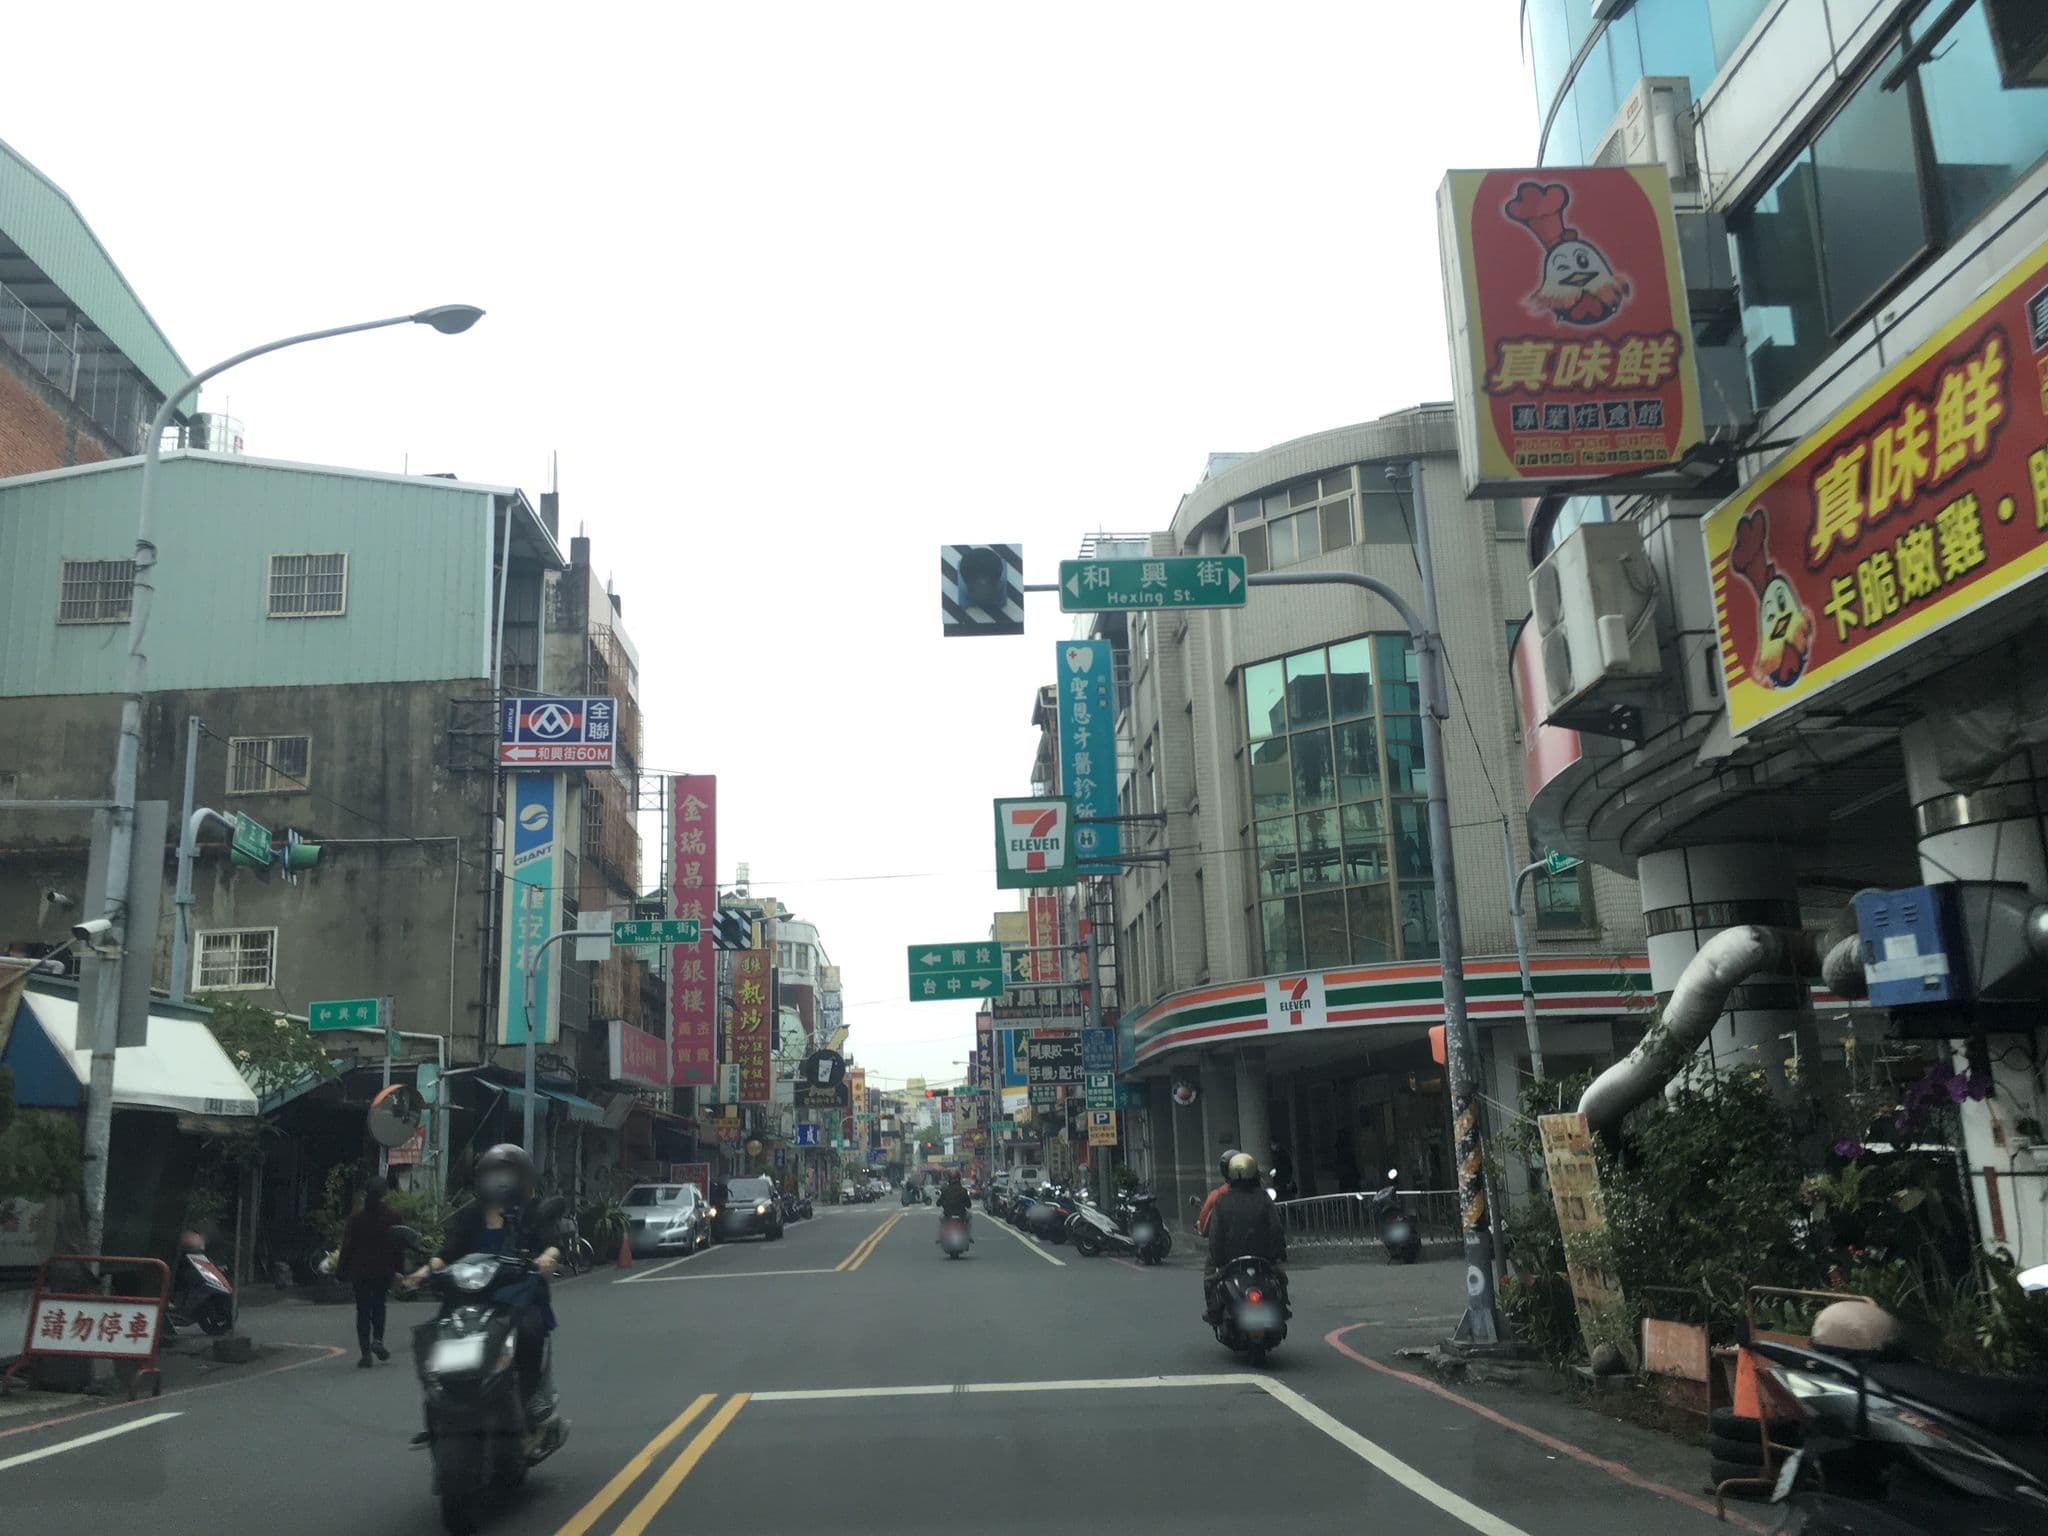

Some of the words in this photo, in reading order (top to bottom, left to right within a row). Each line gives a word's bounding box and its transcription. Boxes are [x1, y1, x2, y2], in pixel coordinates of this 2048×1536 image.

[1492, 337, 1676, 391] 真味鮮
[1811, 339, 2004, 562] 真味鮮
[1083, 561, 1224, 590] 和興街
[1107, 590, 1164, 606] Hexing
[1173, 589, 1196, 602] St.
[588, 702, 610, 739] 全聯
[538, 746, 609, 761] 和興街60M
[513, 845, 553, 867] GIANT
[623, 921, 689, 936] 和興街
[952, 948, 991, 966] 南投
[923, 976, 961, 994] 台中
[739, 979, 766, 1033] 熱炒
[41, 1308, 150, 1344] 請勿停車
